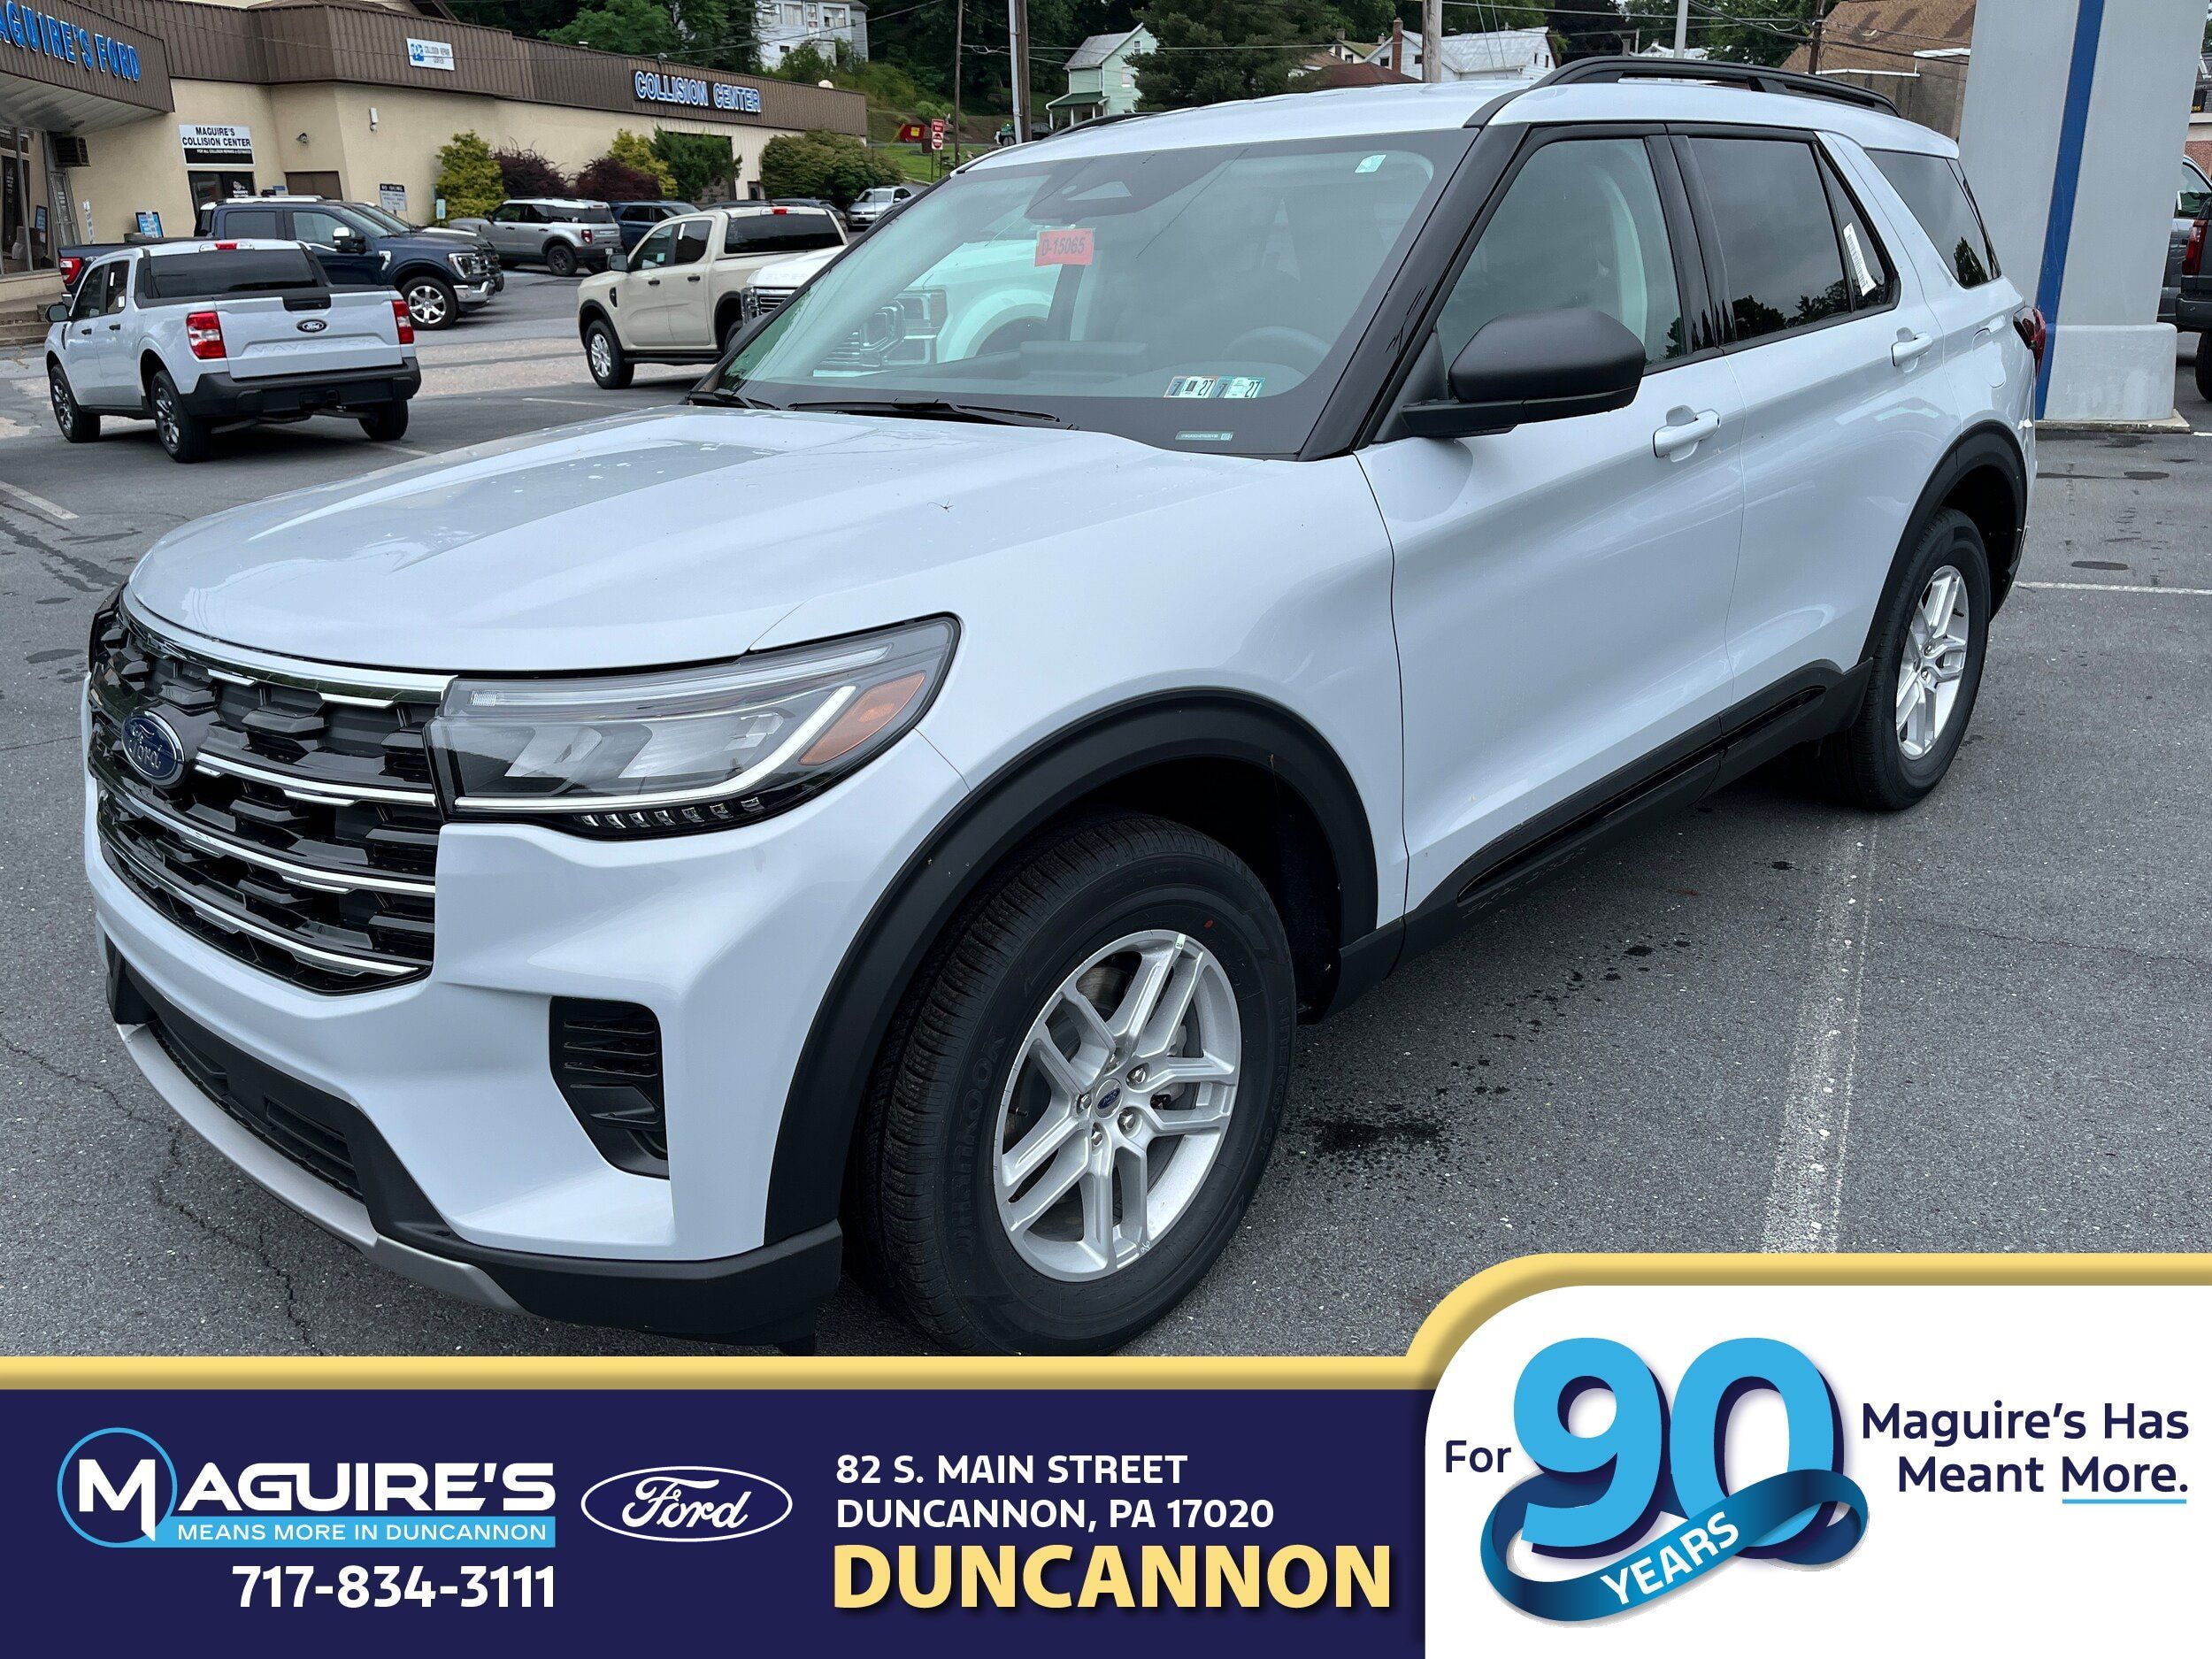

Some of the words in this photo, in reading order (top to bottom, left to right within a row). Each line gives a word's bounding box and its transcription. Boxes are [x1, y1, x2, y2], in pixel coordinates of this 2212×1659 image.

[94, 33, 142, 81] FORD
[634, 70, 709, 106] COLLISION
[712, 82, 762, 113] CENTER
[195, 127, 236, 137] MAGUIRE'S
[181, 136, 221, 147] COLLISION
[222, 138, 251, 148] CENTER
[1197, 380, 1214, 396] 27
[1244, 380, 1261, 398] 27
